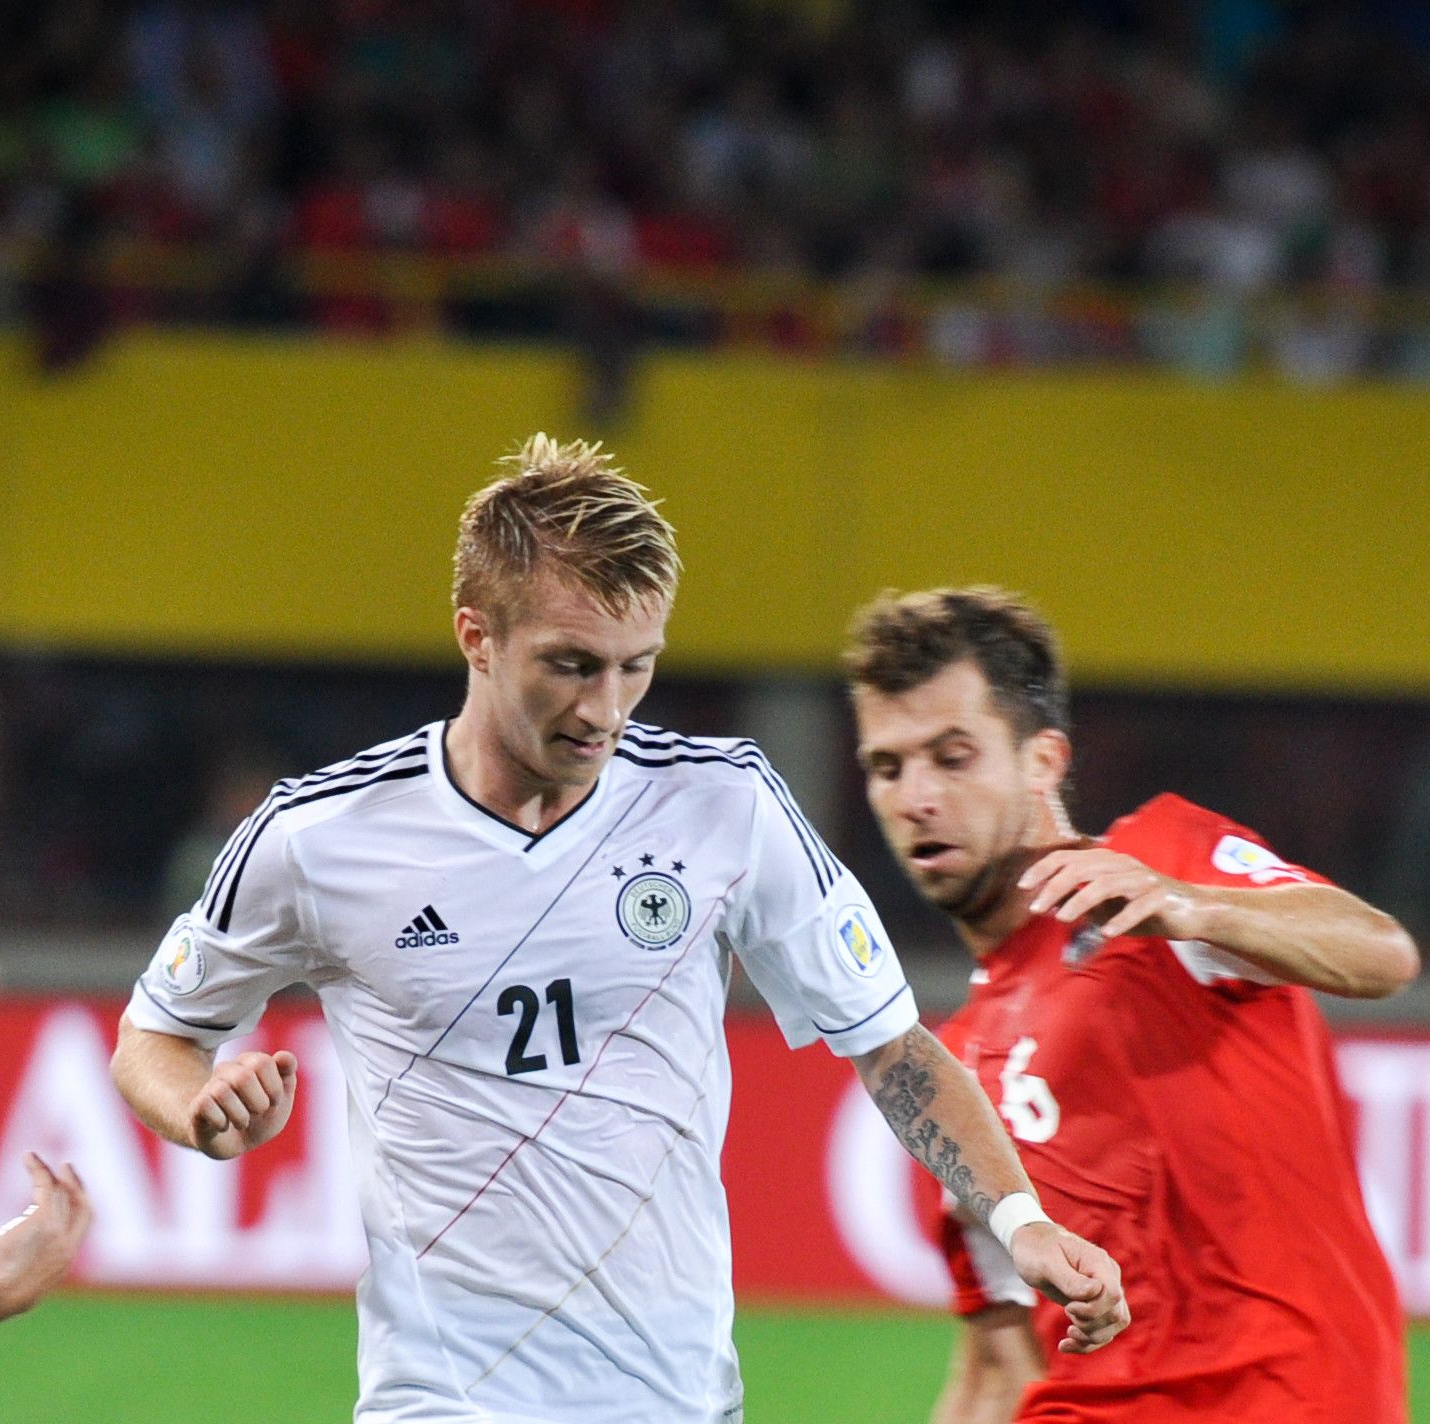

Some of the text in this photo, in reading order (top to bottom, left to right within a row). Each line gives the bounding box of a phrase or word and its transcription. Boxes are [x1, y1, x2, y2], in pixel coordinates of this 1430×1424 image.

[394, 930, 460, 949] adidas
[497, 978, 581, 1076] 21
[999, 1036, 1061, 1144] 6
